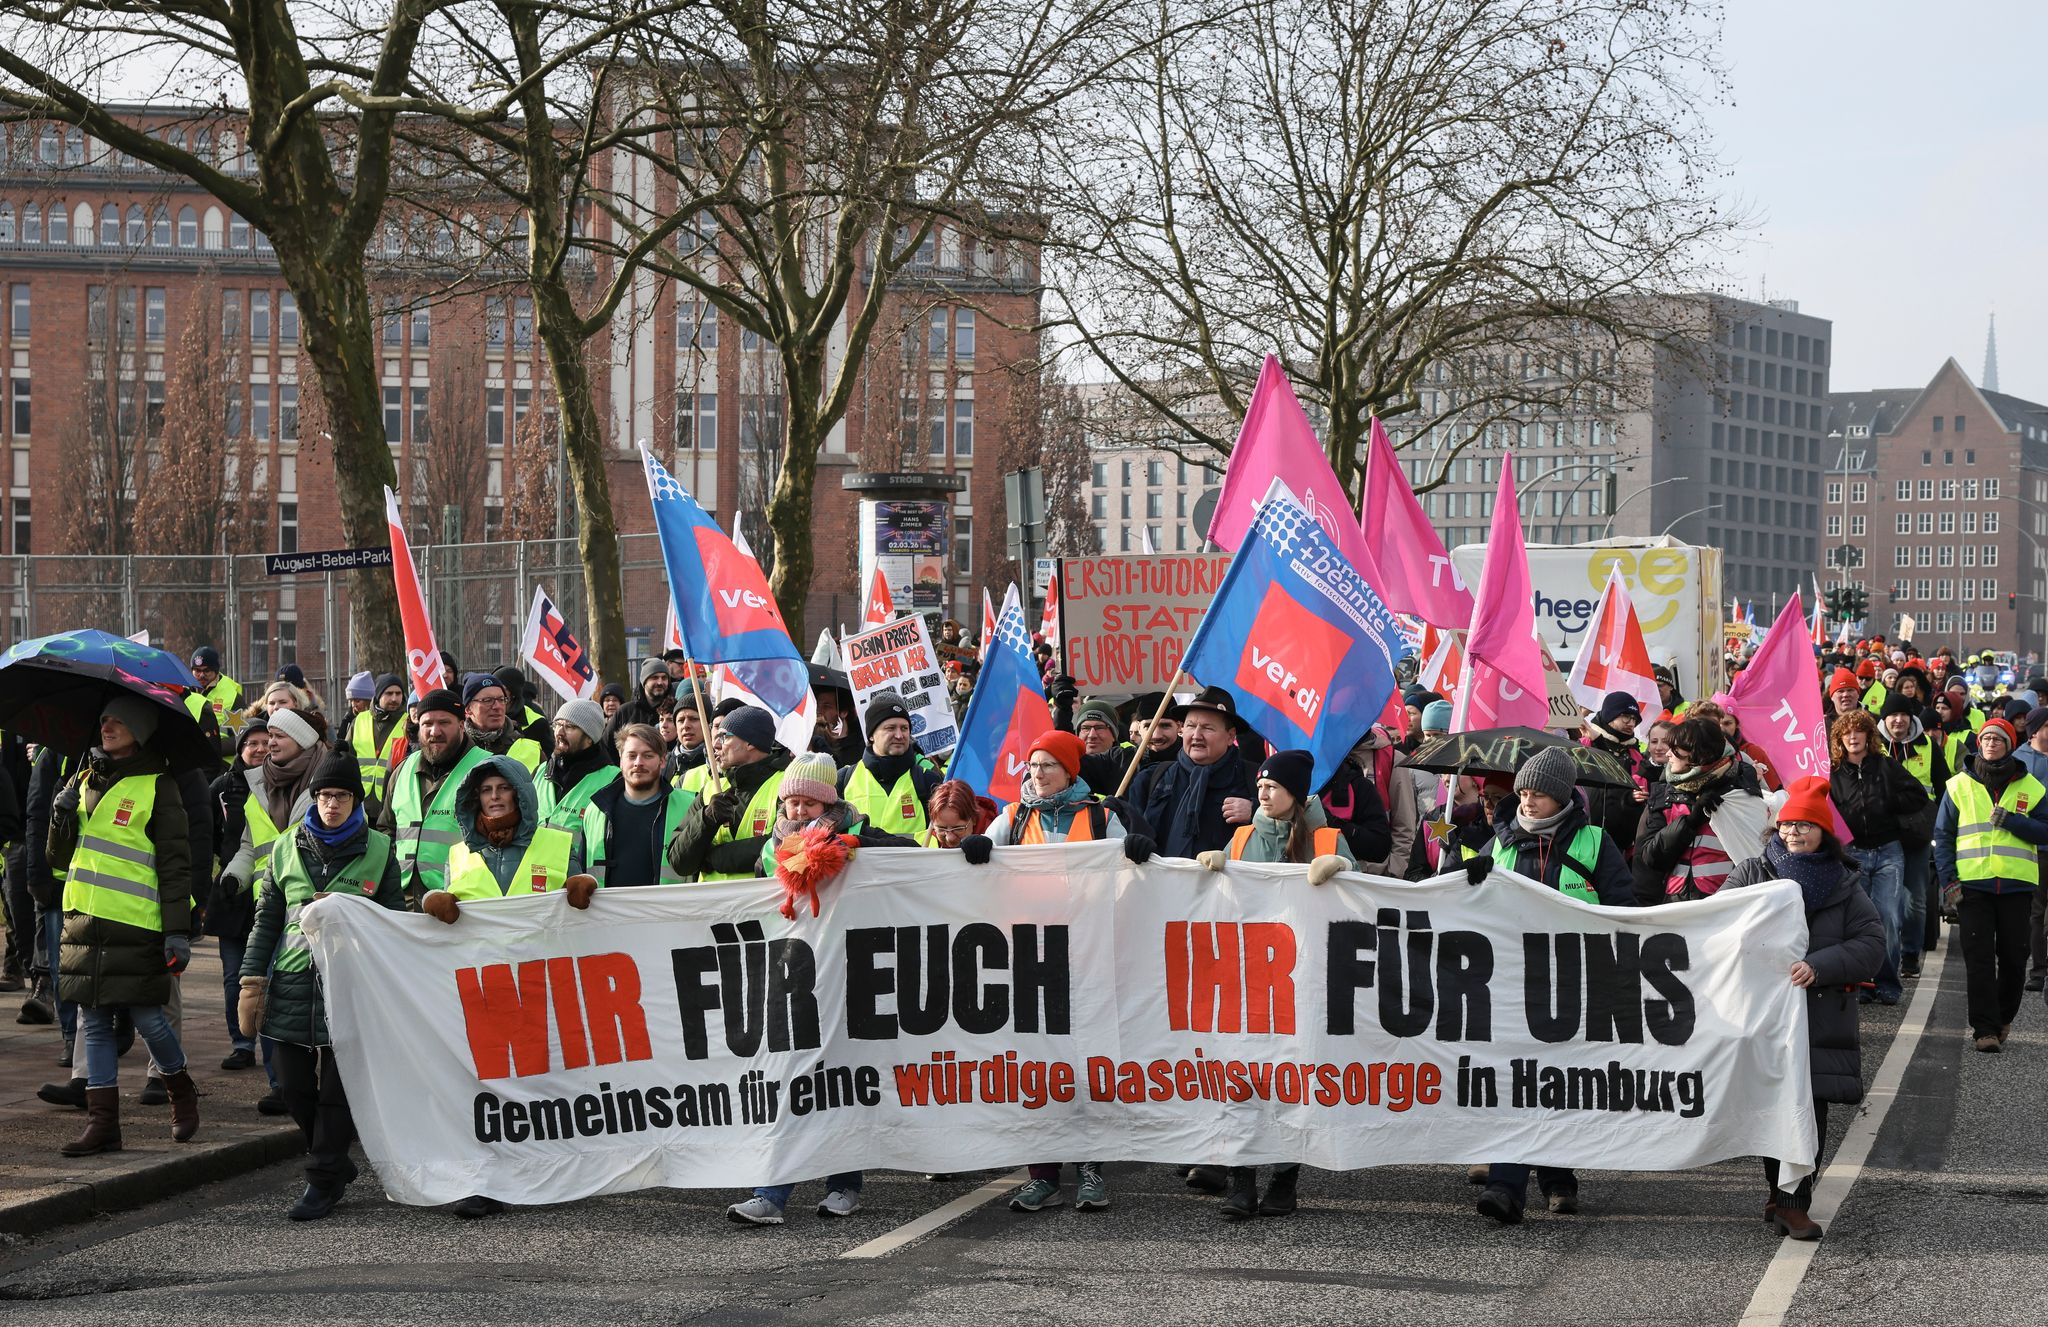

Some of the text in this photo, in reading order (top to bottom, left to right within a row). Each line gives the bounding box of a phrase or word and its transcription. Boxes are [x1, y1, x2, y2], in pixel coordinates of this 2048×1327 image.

[889, 475, 924, 484] STRÖER
[272, 550, 391, 573] August-Bebel-Park
[1102, 603, 1208, 633] STAT
[850, 634, 886, 661] DENN
[1251, 645, 1322, 720] ver.di
[1769, 697, 1807, 743] TV
[339, 876, 360, 887] MUSIK
[455, 907, 1697, 1081] WIR FÜR EUCH IHR FÜR UNS
[473, 1047, 1706, 1145] Gemeinsam für eine würdige Daseinsvorsorge in Hamburg
